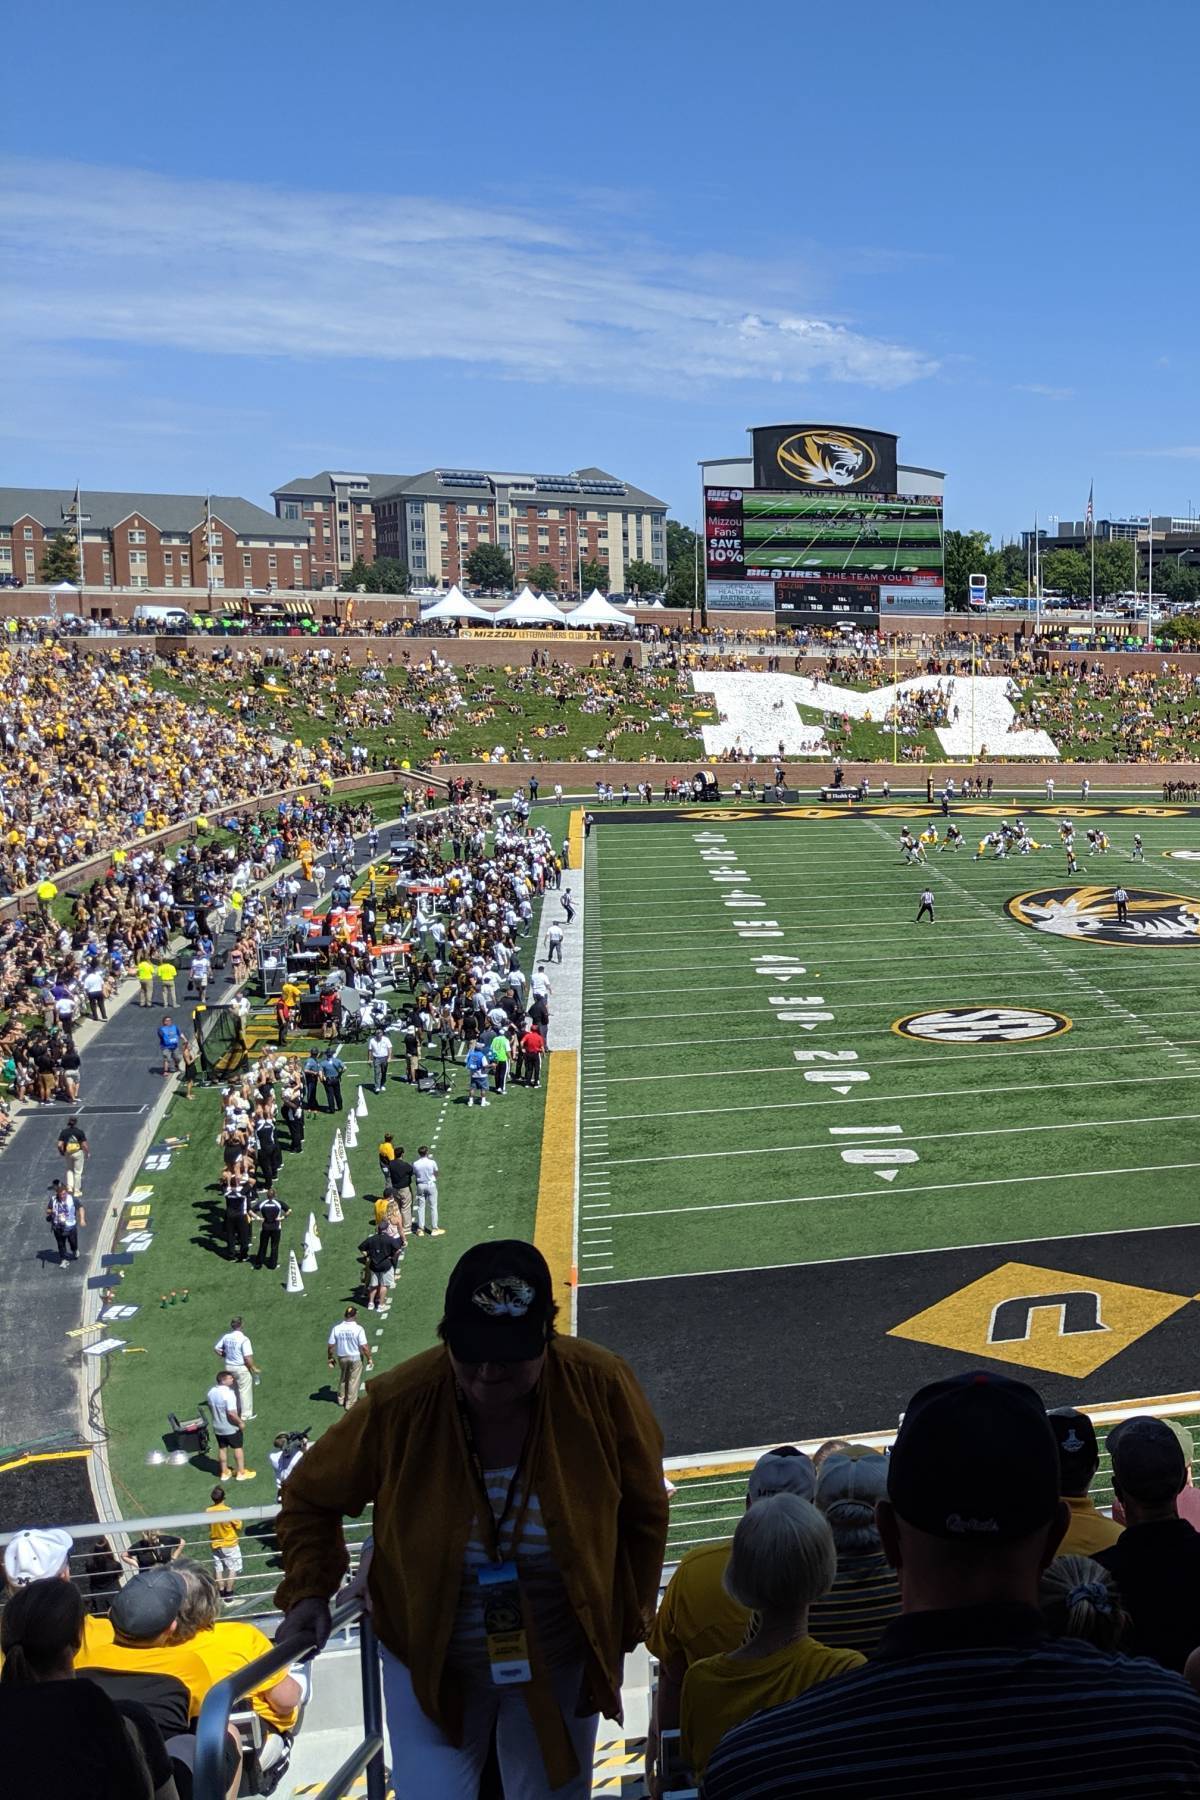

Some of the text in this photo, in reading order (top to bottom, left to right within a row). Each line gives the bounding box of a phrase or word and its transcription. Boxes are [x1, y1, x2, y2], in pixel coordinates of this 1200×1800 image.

[708, 517, 742, 527] Mizzou
[714, 528, 737, 537] Fans
[710, 539, 742, 549] SAVE
[708, 550, 744, 562] 10%
[747, 569, 771, 578] BIG
[783, 571, 822, 579] TIRES
[826, 572, 847, 580] THE
[906, 575, 940, 584] TRUST
[586, 632, 597, 640] M
[768, 996, 835, 1021] 30
[793, 1050, 871, 1082] 20
[829, 1125, 920, 1164] 10
[290, 1257, 298, 1288] MIZZOU
[17, 1577, 31, 1585] M
